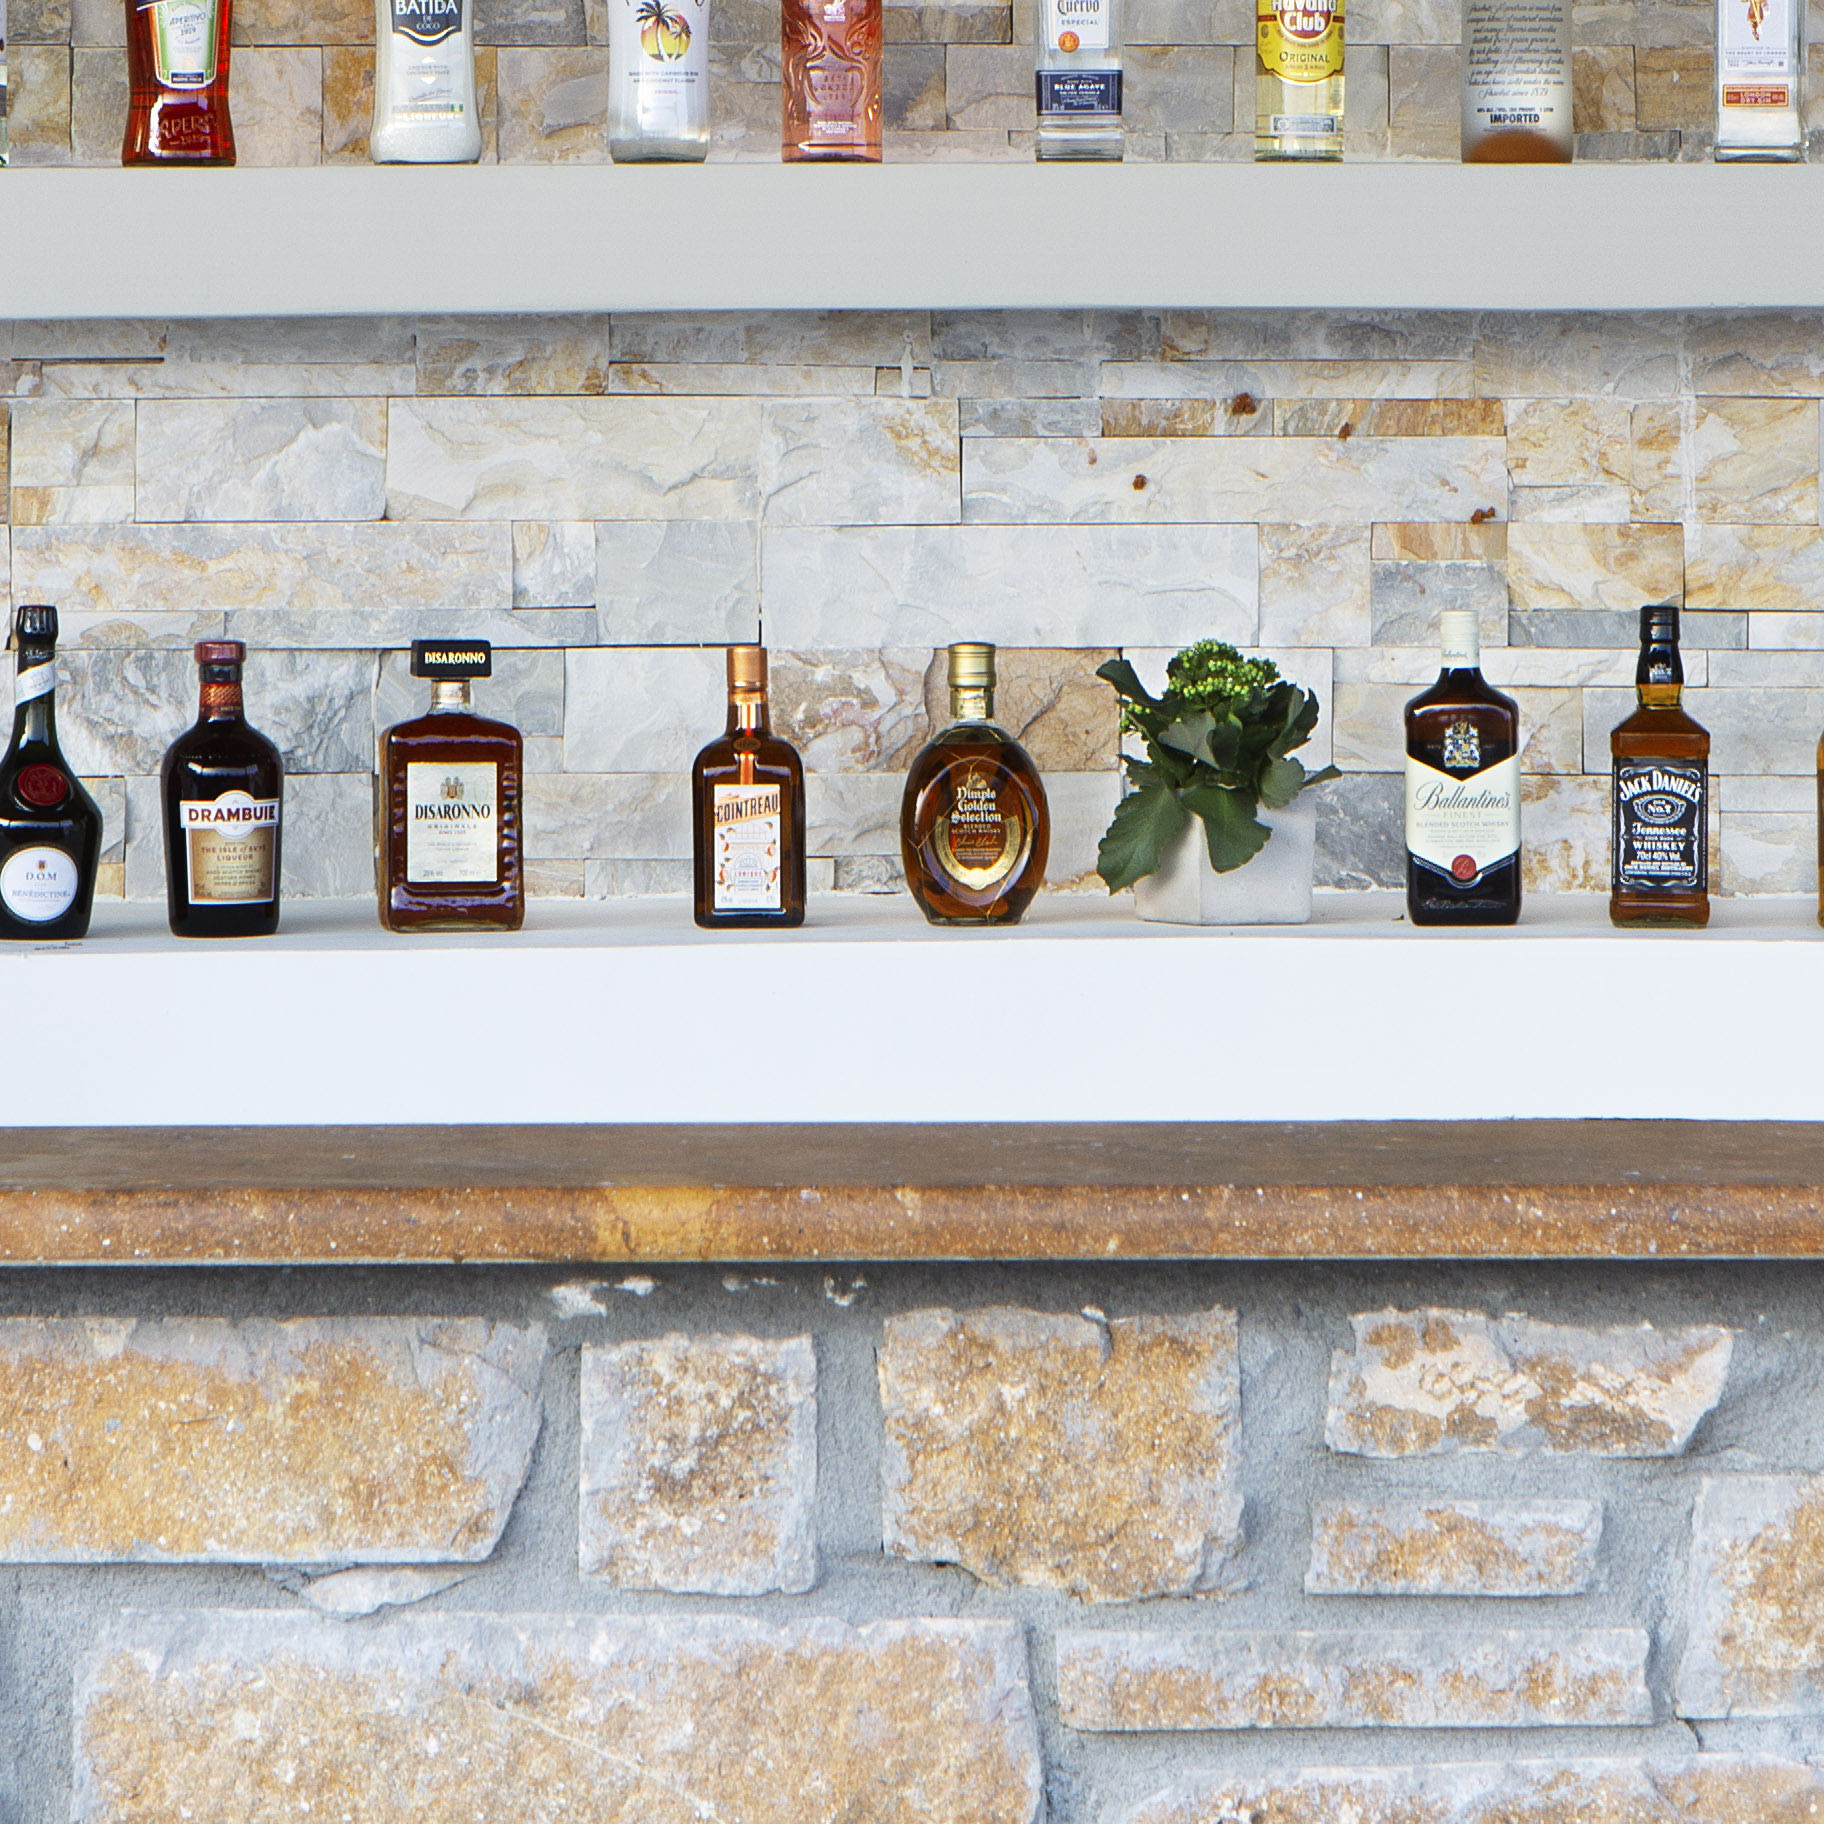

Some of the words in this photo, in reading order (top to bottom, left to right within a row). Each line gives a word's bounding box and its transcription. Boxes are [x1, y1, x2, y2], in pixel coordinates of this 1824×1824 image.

[1283, 13, 1326, 32] Club
[1489, 113, 1540, 125] IMPORTED
[424, 651, 486, 665] DISARONNO
[957, 786, 997, 801] Dimple
[1619, 775, 1652, 801] JACK
[1652, 770, 1703, 803] DANIEL'S
[1414, 780, 1511, 810] Ballantine's
[189, 805, 275, 822] DRAMBUIE
[415, 804, 491, 821] DISARONNO
[717, 793, 778, 823] COINTREAU
[958, 800, 996, 813] Golden
[951, 810, 1002, 824] Selection
[1632, 822, 1687, 836] Tennessee
[1632, 841, 1686, 851] WHISKEY
[217, 854, 254, 862] LIQUEUR
